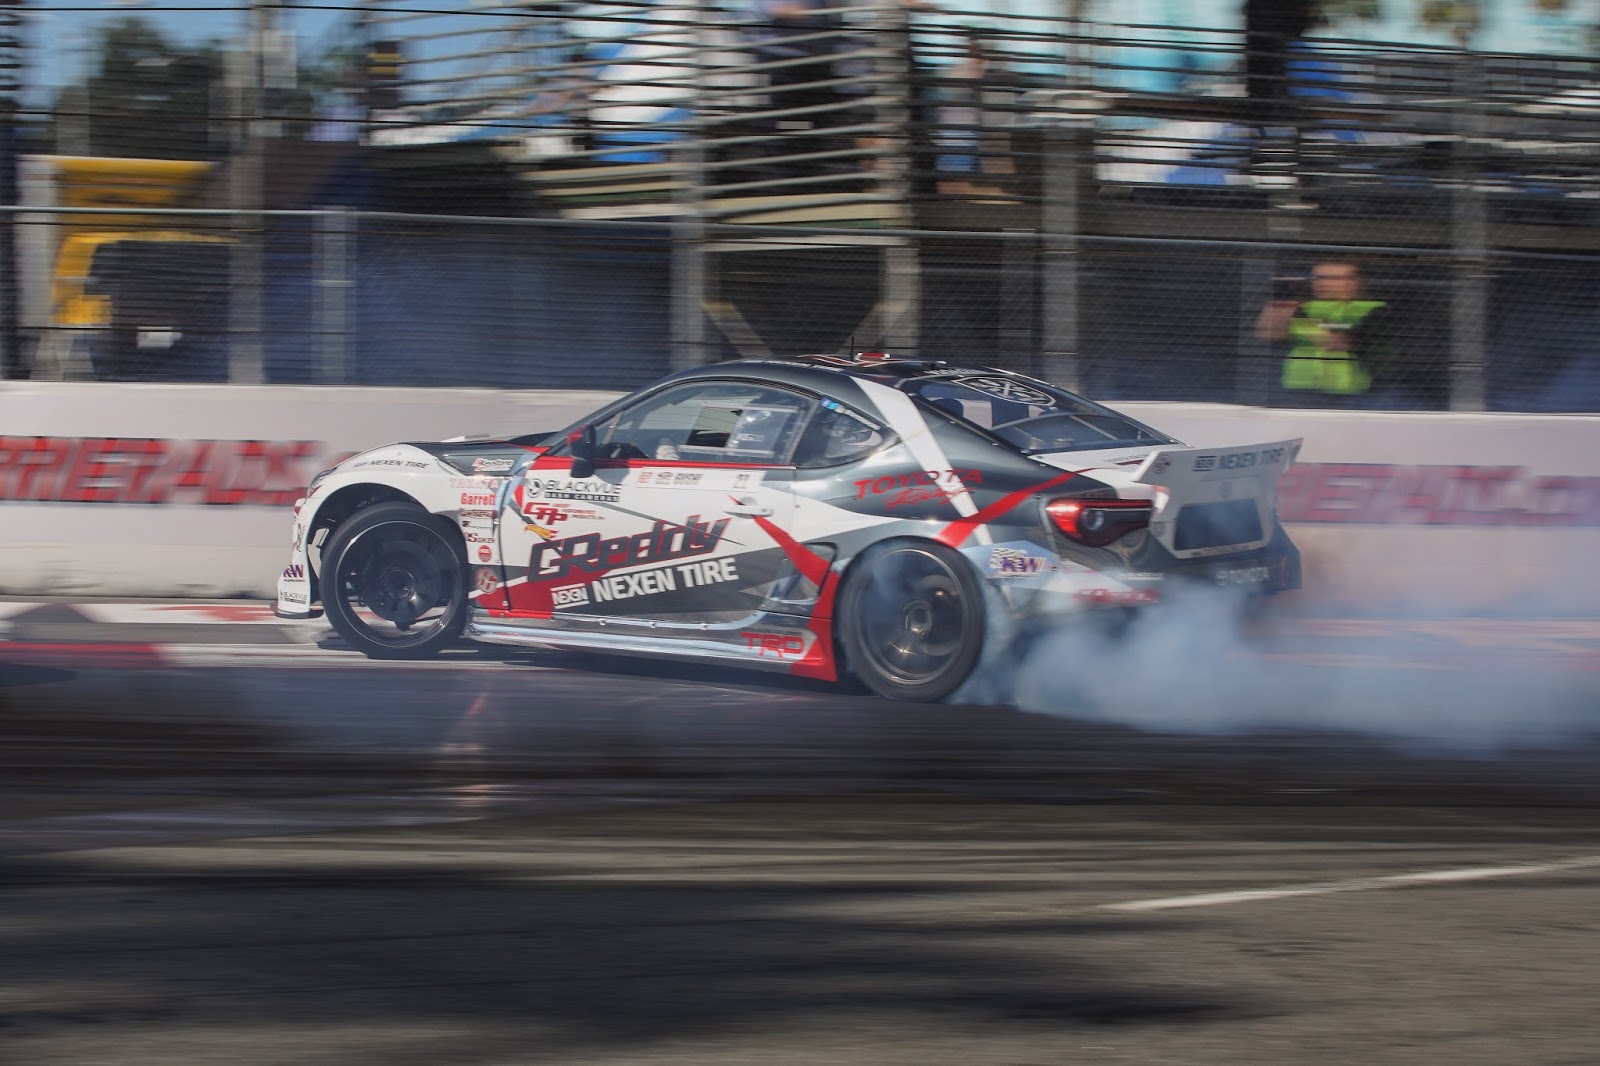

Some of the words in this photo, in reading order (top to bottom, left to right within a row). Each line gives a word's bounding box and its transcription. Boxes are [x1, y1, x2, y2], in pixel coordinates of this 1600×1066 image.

[405, 460, 430, 469] TIRE
[546, 479, 622, 494] BLACKVUE
[852, 468, 984, 500] TOYOTA
[461, 492, 496, 506] Garrett
[574, 493, 619, 502] CAMERAS
[526, 514, 732, 583] GReddy
[592, 568, 677, 602] NEXEN
[677, 557, 739, 589] TIRE
[739, 631, 806, 659] TRD
